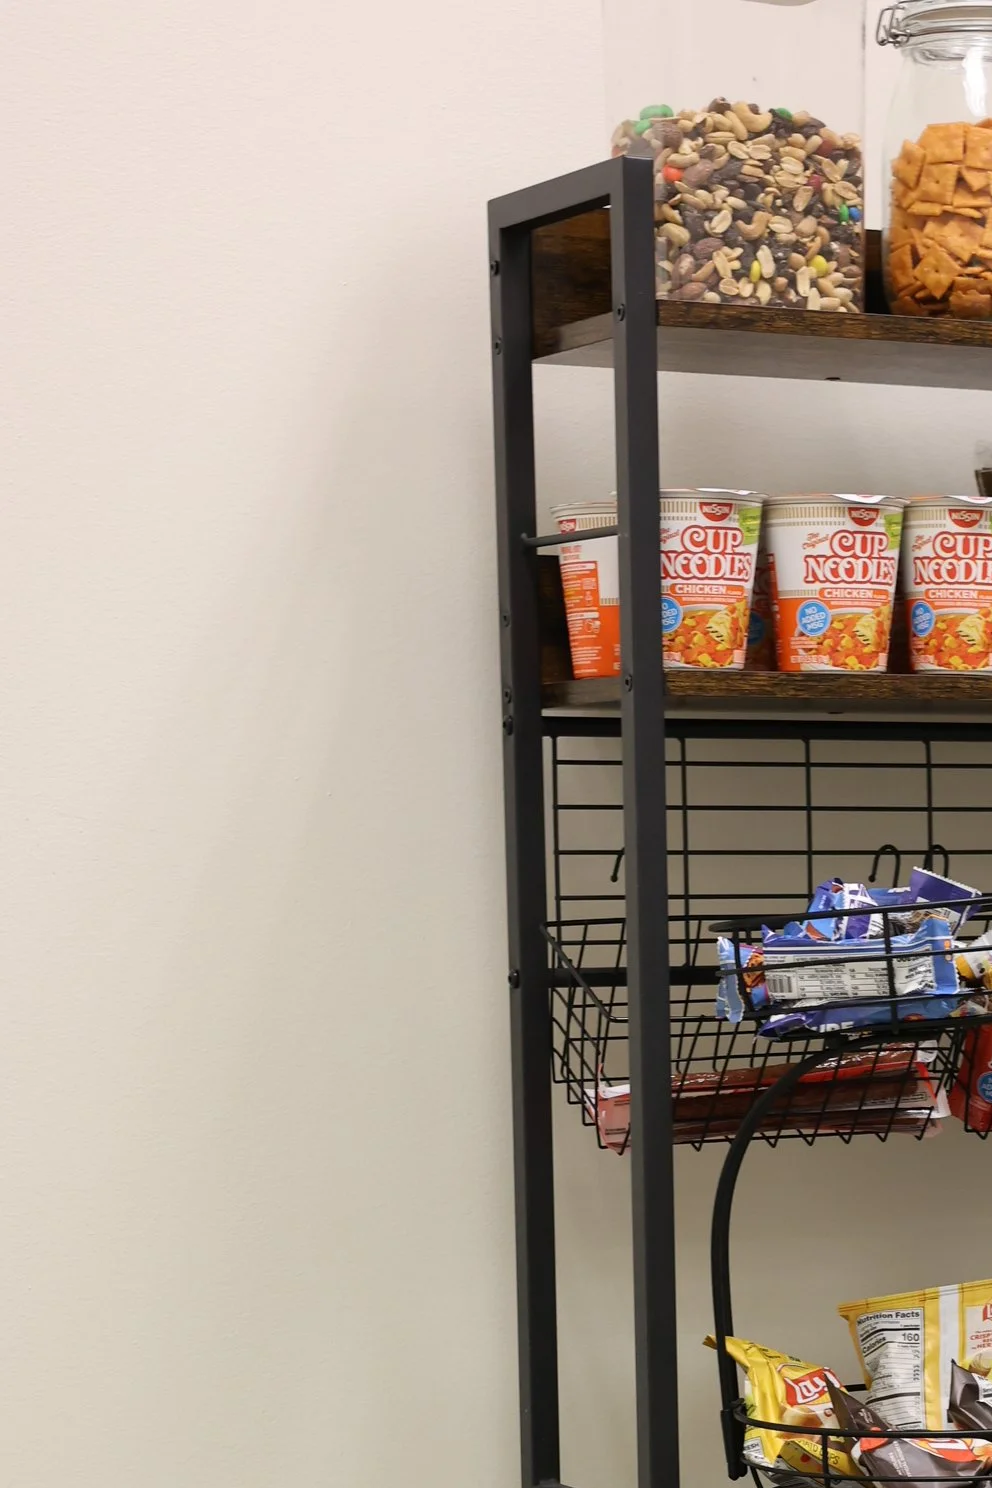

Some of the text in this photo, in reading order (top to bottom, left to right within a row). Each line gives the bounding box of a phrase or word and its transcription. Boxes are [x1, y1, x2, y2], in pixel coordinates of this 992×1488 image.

[851, 509, 877, 520] NISSIN
[950, 510, 981, 522] NISSIN
[681, 525, 744, 554] CUP
[830, 530, 889, 557] CUP
[660, 552, 752, 581] NOODLES
[803, 554, 896, 585] NOODLES
[675, 584, 727, 595] CHICKEN
[824, 588, 873, 599] CHICKEN
[928, 589, 978, 600] CHICKEN
[857, 1310, 920, 1324] Nutrition Facts
[902, 1332, 920, 1342] 160
